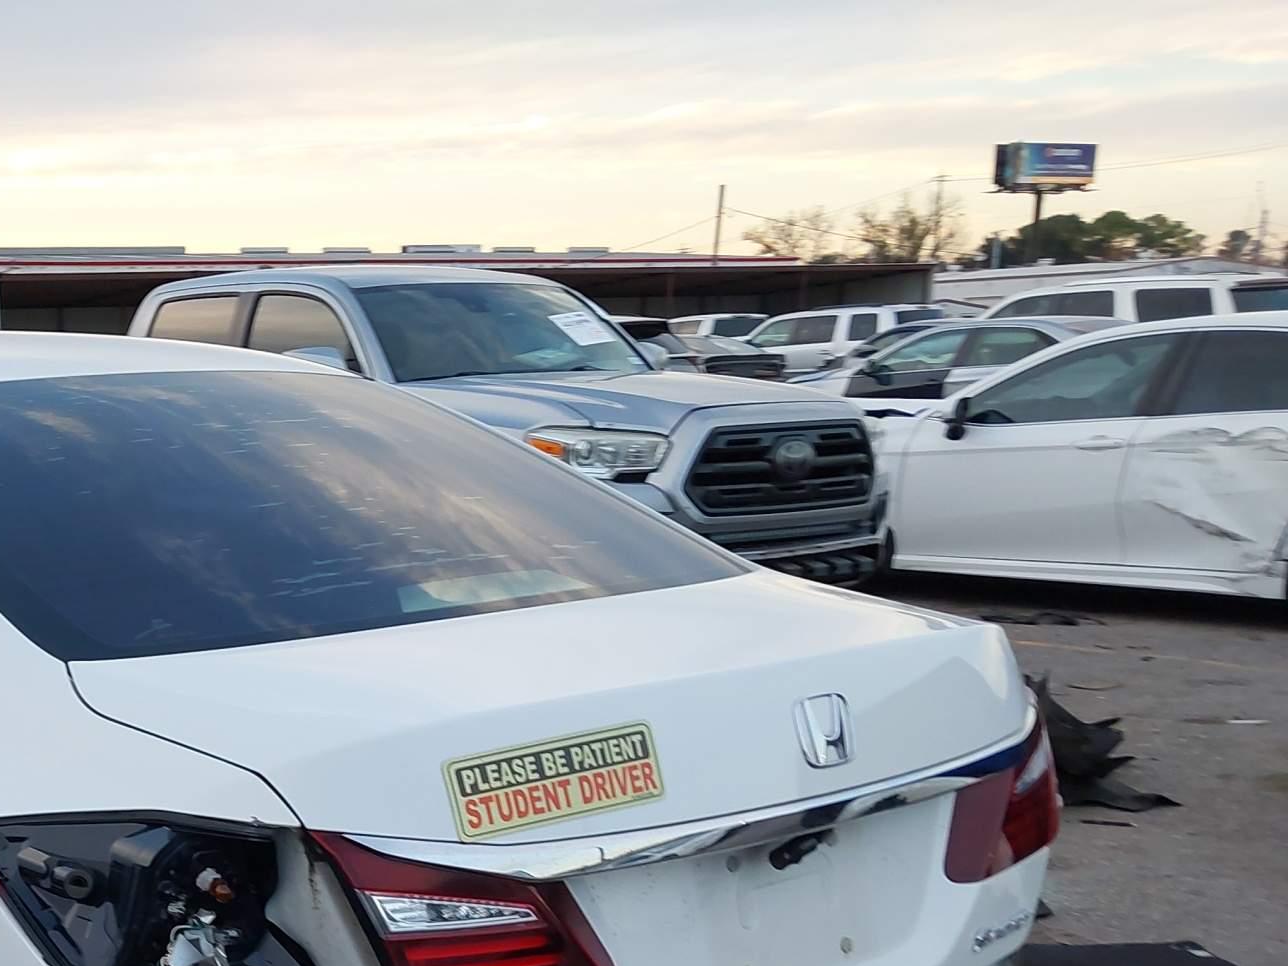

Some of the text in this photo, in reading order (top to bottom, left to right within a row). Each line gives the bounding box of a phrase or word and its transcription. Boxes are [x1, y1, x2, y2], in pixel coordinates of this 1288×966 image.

[461, 734, 646, 793] PLEASE BE PATIENT
[465, 761, 658, 829] STUDENT DRIVER
